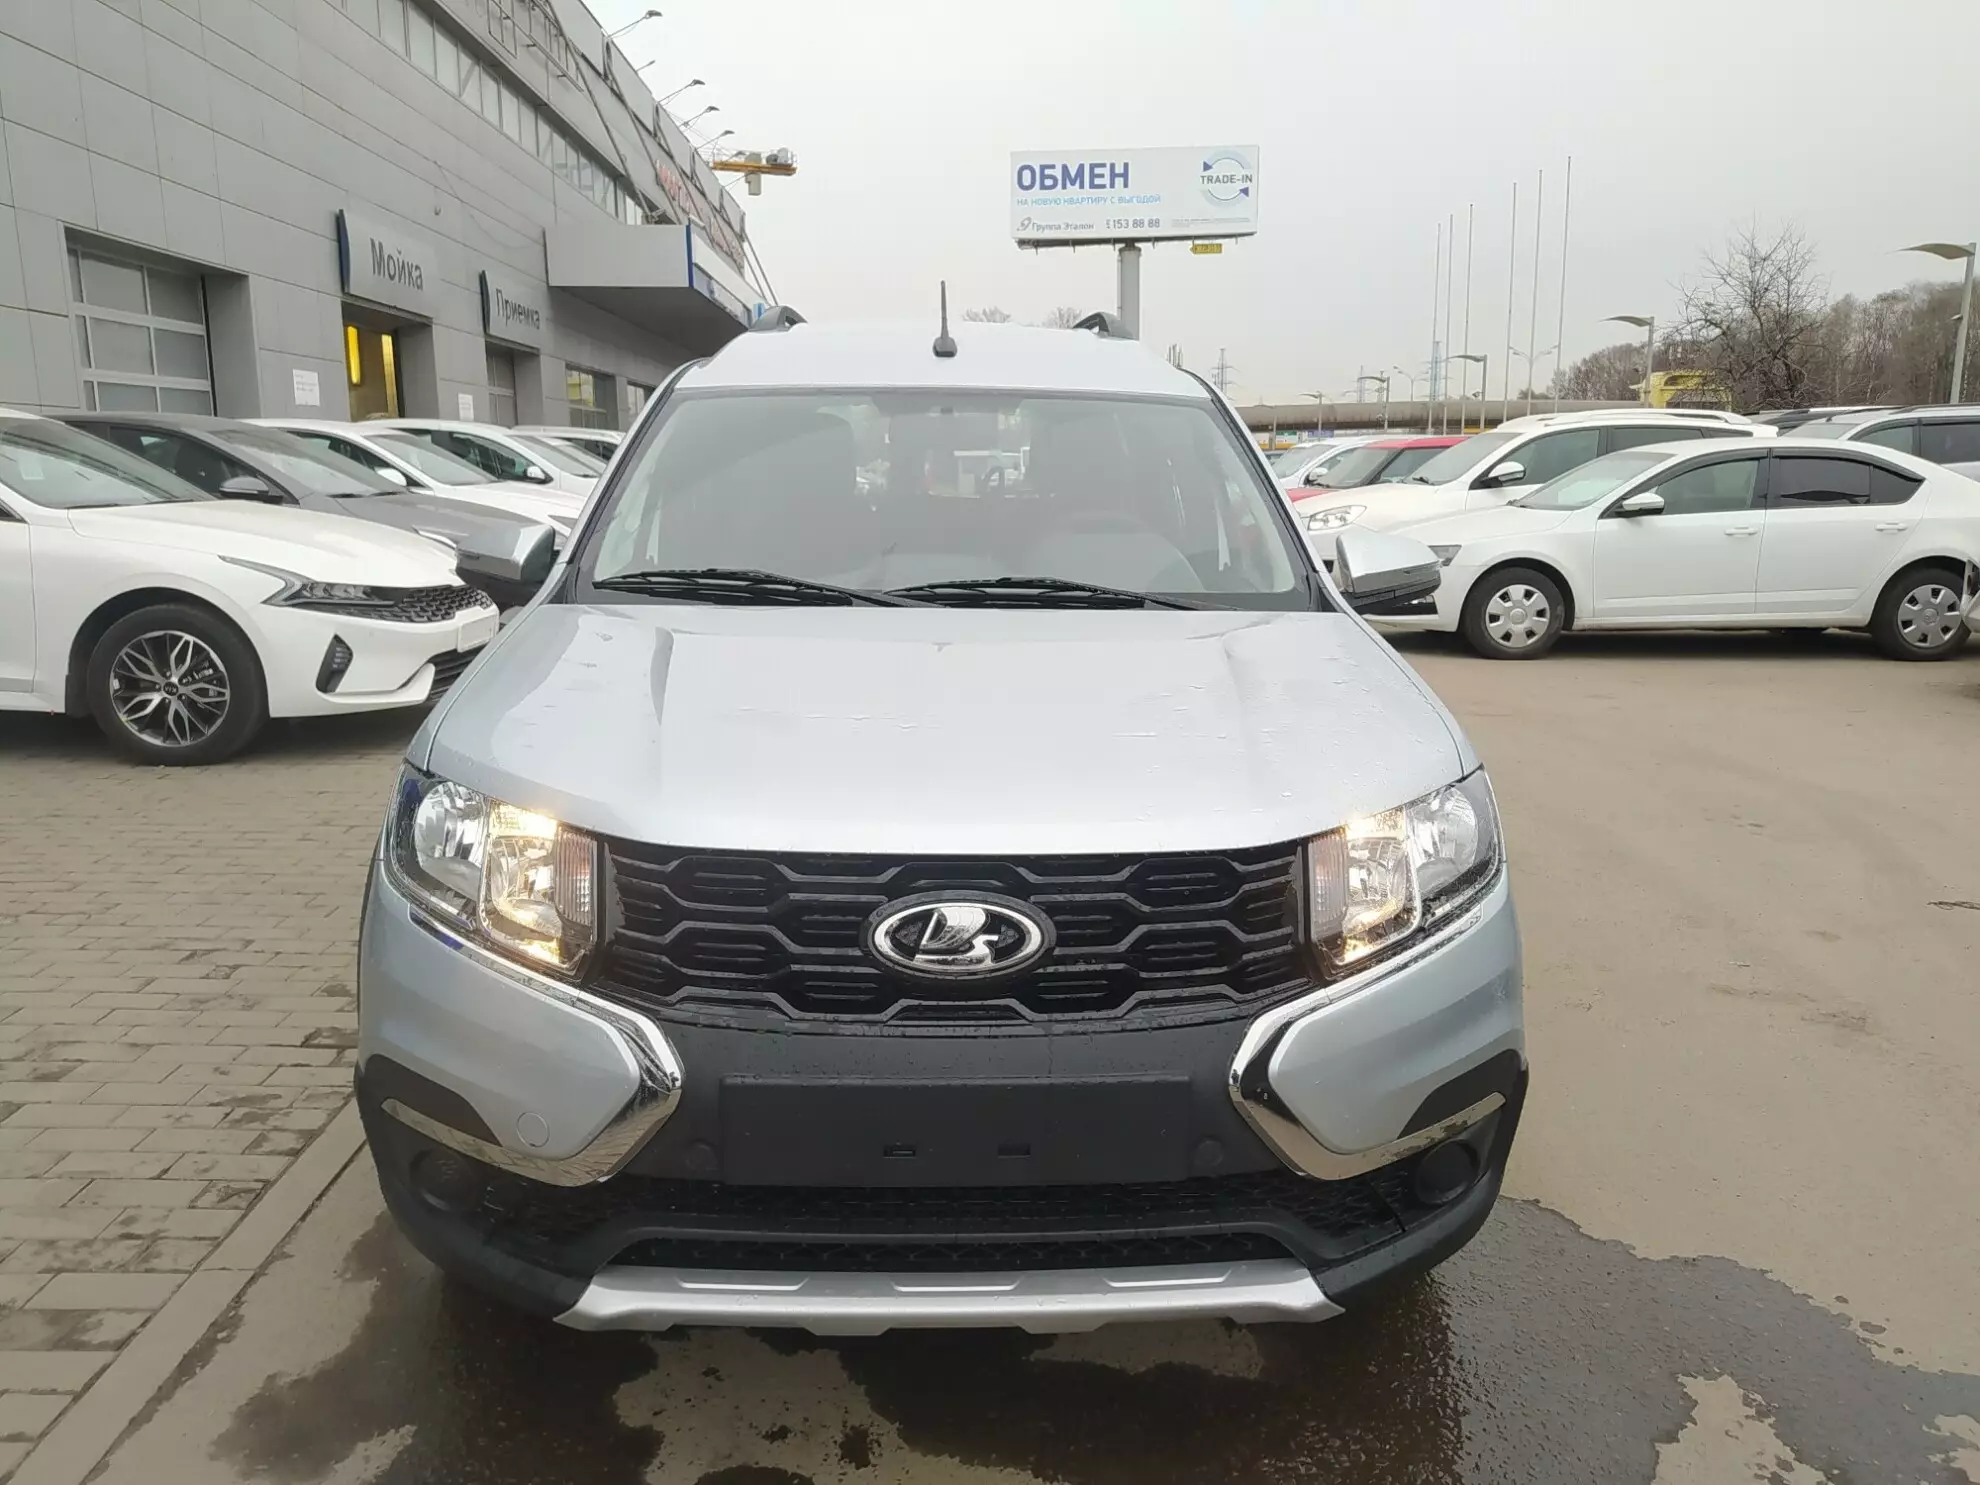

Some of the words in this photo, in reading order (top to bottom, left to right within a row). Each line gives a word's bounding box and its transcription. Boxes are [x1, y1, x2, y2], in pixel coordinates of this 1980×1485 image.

[1017, 162, 1130, 191] ОБМЕН
[1200, 174, 1253, 185] TRADE-IN
[1017, 198, 1029, 206] НА
[1031, 197, 1062, 206] НОВУЮ
[1063, 196, 1108, 206] КВАРТИРУ
[1110, 196, 1117, 204] С
[1118, 194, 1162, 205] ВЫГОДОЙ
[1032, 221, 1061, 233] Группа
[1063, 221, 1094, 231] Эталон
[1113, 218, 1130, 229] 153
[1132, 218, 1145, 229] 88
[1148, 218, 1160, 228] 88
[370, 237, 424, 291] Мойка
[495, 287, 541, 331] Приемка
